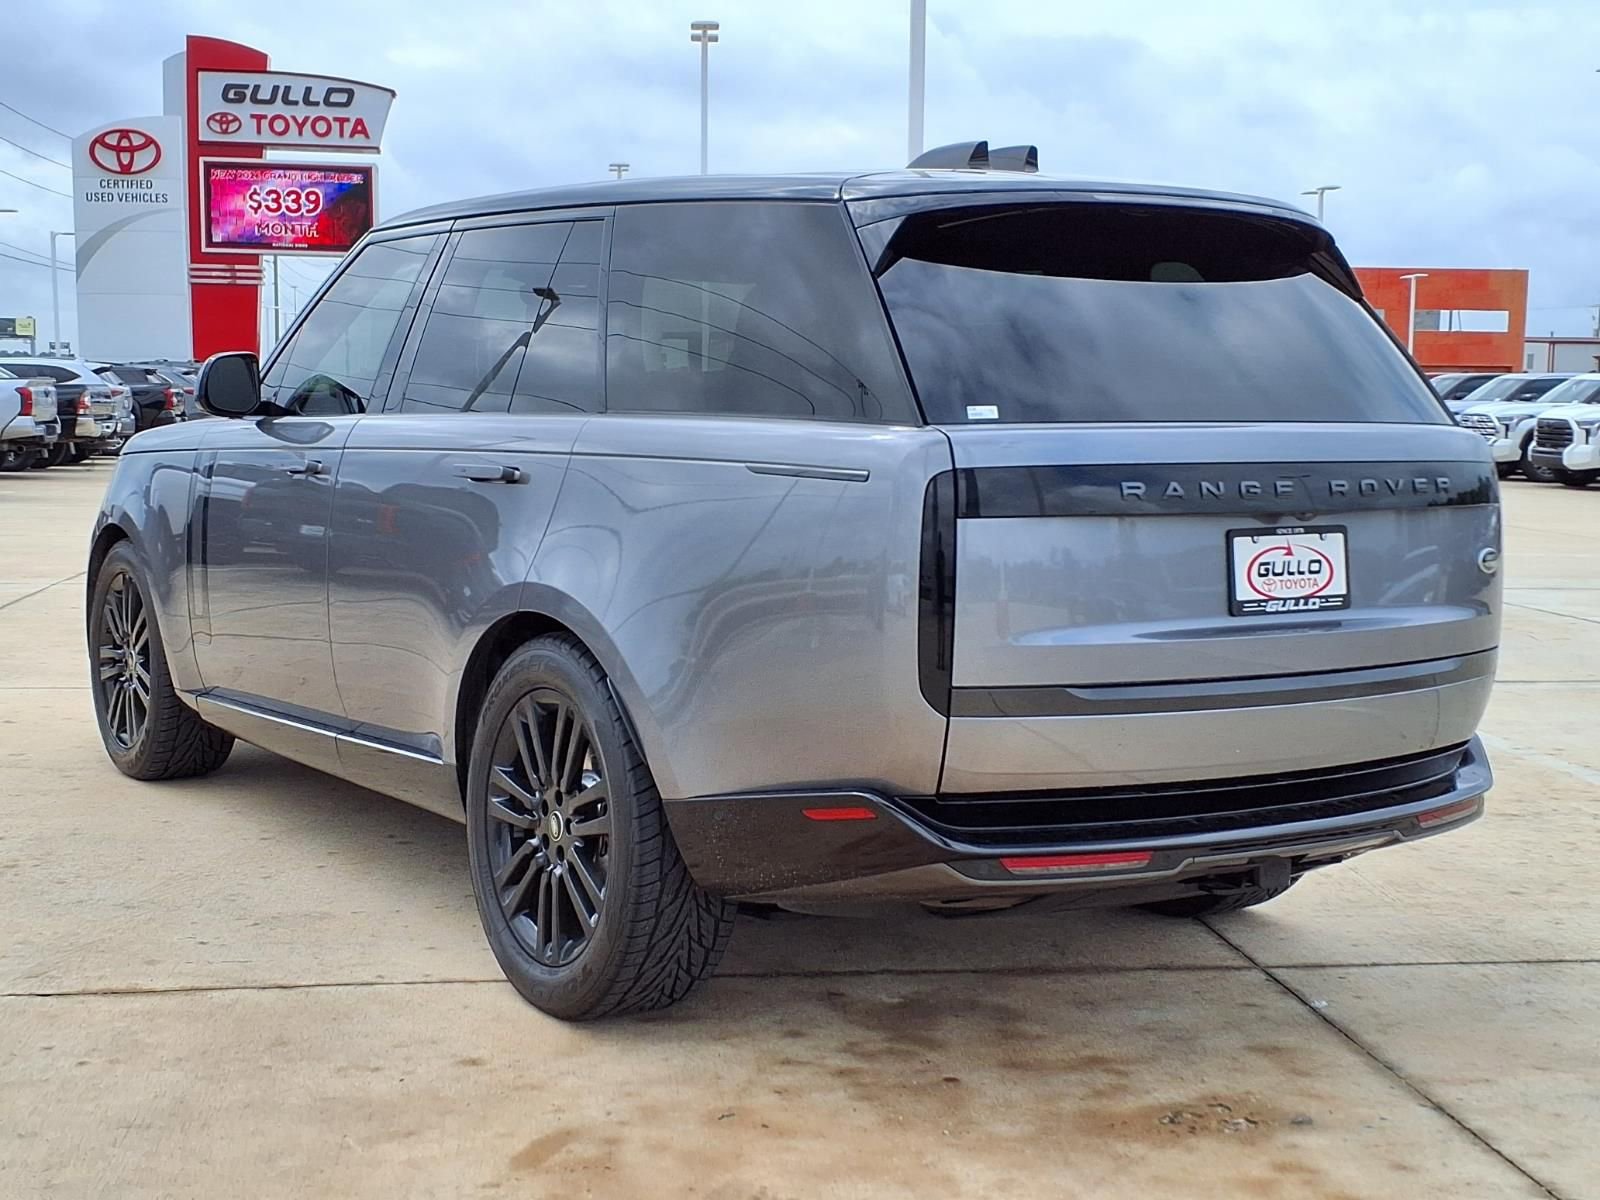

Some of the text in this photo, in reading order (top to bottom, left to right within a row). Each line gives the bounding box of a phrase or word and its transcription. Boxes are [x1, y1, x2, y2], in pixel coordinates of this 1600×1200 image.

[221, 83, 356, 107] GULLO
[250, 113, 370, 139] TOYOTA
[99, 178, 153, 190] CERTIFIED
[85, 191, 169, 204] USED VEHICLES
[247, 186, 322, 216] $339
[254, 222, 320, 238] MONTH
[1119, 476, 1452, 500] RANGE ROVER
[1257, 559, 1322, 578] GULLO
[1277, 578, 1320, 590] TOYOTA
[1265, 598, 1321, 612] GULLO
